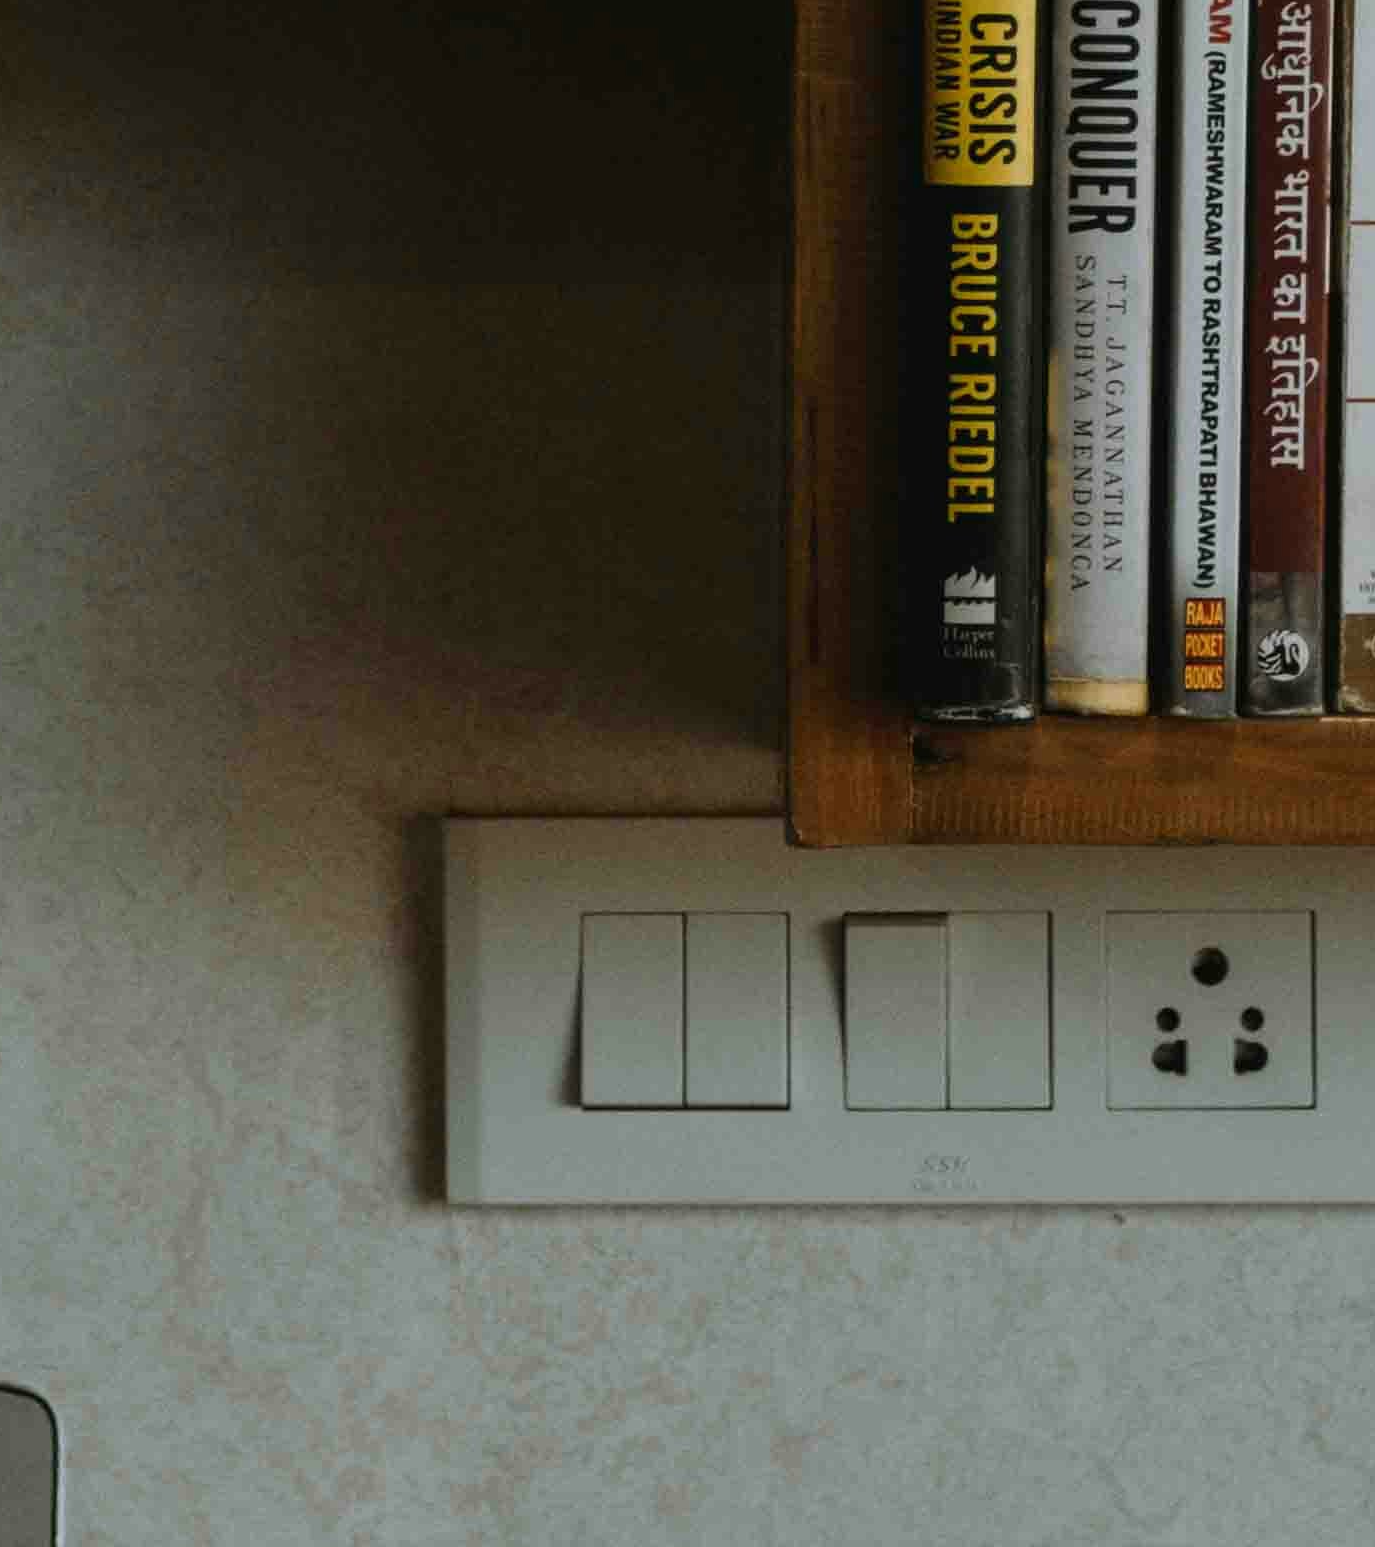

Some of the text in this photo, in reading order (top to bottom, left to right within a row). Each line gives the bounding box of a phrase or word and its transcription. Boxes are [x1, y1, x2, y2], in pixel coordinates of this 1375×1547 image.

[969, 14, 1015, 166] CRISIS
[1261, 2, 1323, 469] आधुनिक भारत का इतिहास
[946, 211, 998, 523] BRUCE RIEDEL
